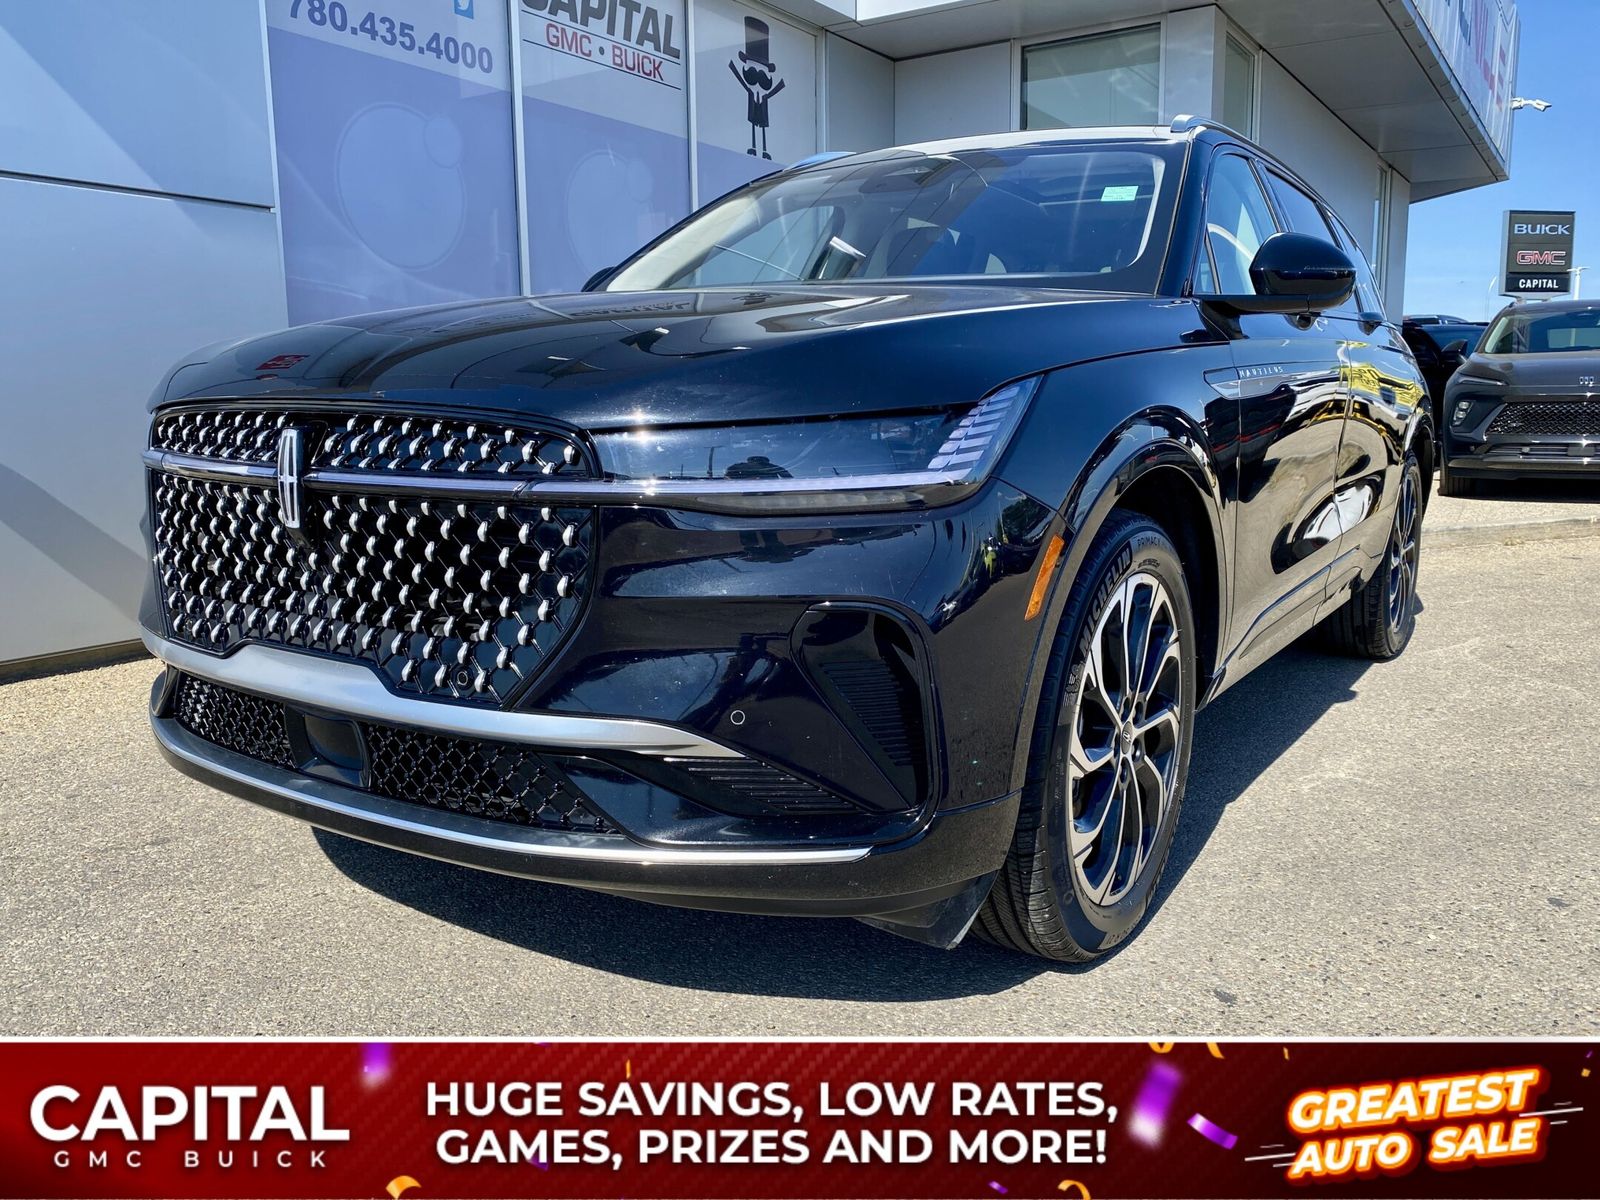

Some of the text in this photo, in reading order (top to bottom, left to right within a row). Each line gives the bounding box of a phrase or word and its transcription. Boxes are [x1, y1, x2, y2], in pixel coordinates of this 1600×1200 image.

[545, 22, 664, 81] GMC BUICK
[1514, 224, 1571, 235] BUICK
[1517, 250, 1567, 266] GMC
[1519, 278, 1559, 289] CAPITAL
[1239, 366, 1284, 378] NAUTILUS
[1079, 547, 1132, 658] MICHELIN
